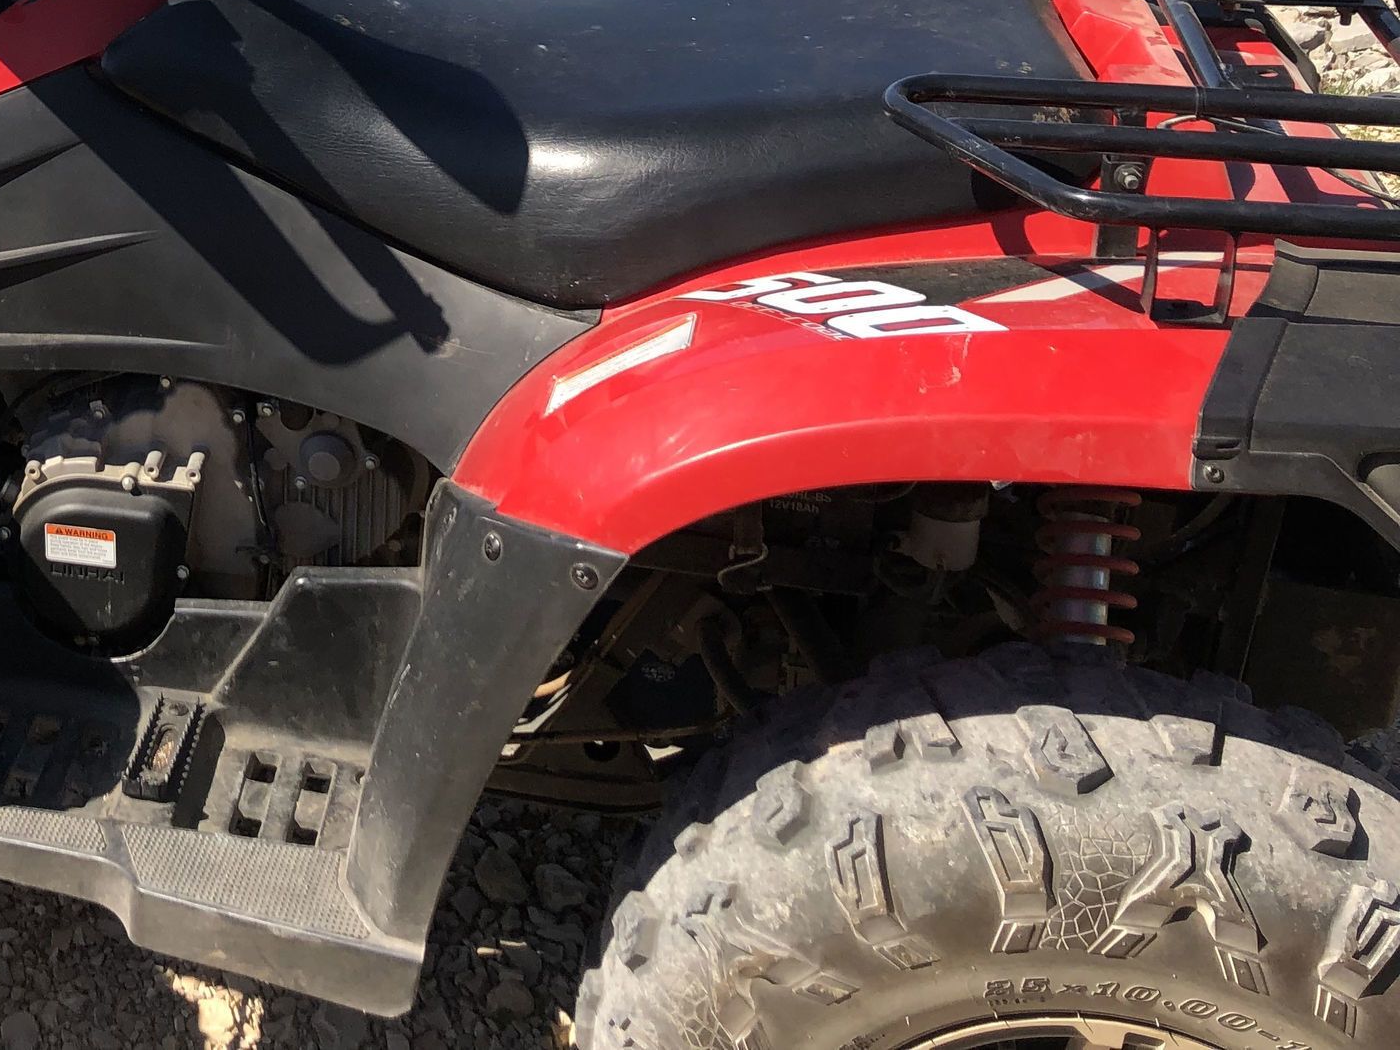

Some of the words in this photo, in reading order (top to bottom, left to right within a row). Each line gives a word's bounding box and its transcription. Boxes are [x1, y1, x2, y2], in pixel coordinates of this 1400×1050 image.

[672, 271, 1010, 338] 500
[65, 528, 108, 540] WARNING
[51, 562, 125, 585] LINHAI
